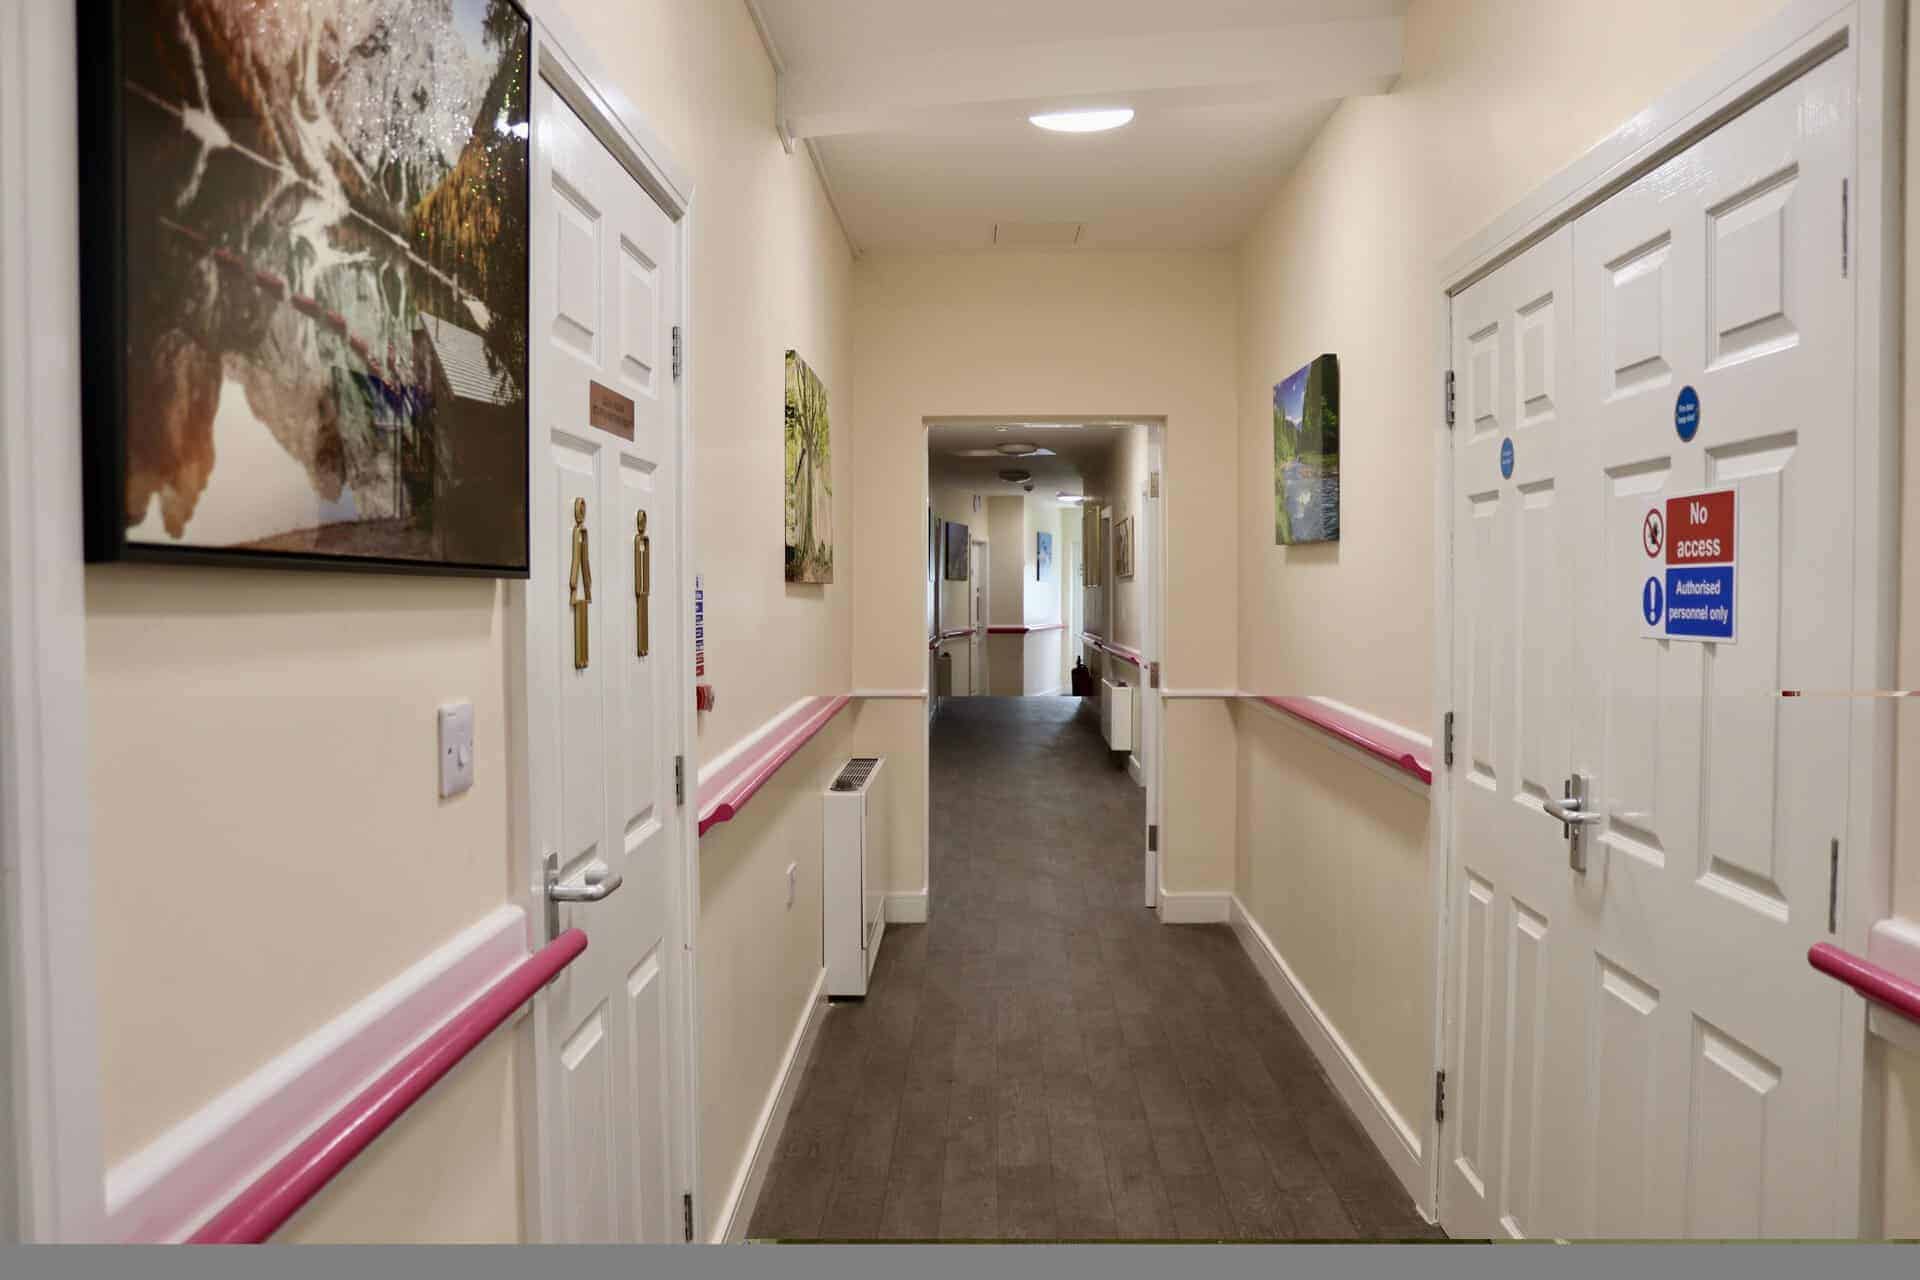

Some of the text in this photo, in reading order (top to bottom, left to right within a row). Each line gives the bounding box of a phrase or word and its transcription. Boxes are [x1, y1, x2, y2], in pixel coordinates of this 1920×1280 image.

[1690, 502, 1708, 525] No
[1676, 538, 1721, 558] access
[1675, 580, 1721, 595] Authorised
[1668, 604, 1728, 625] personnel only
